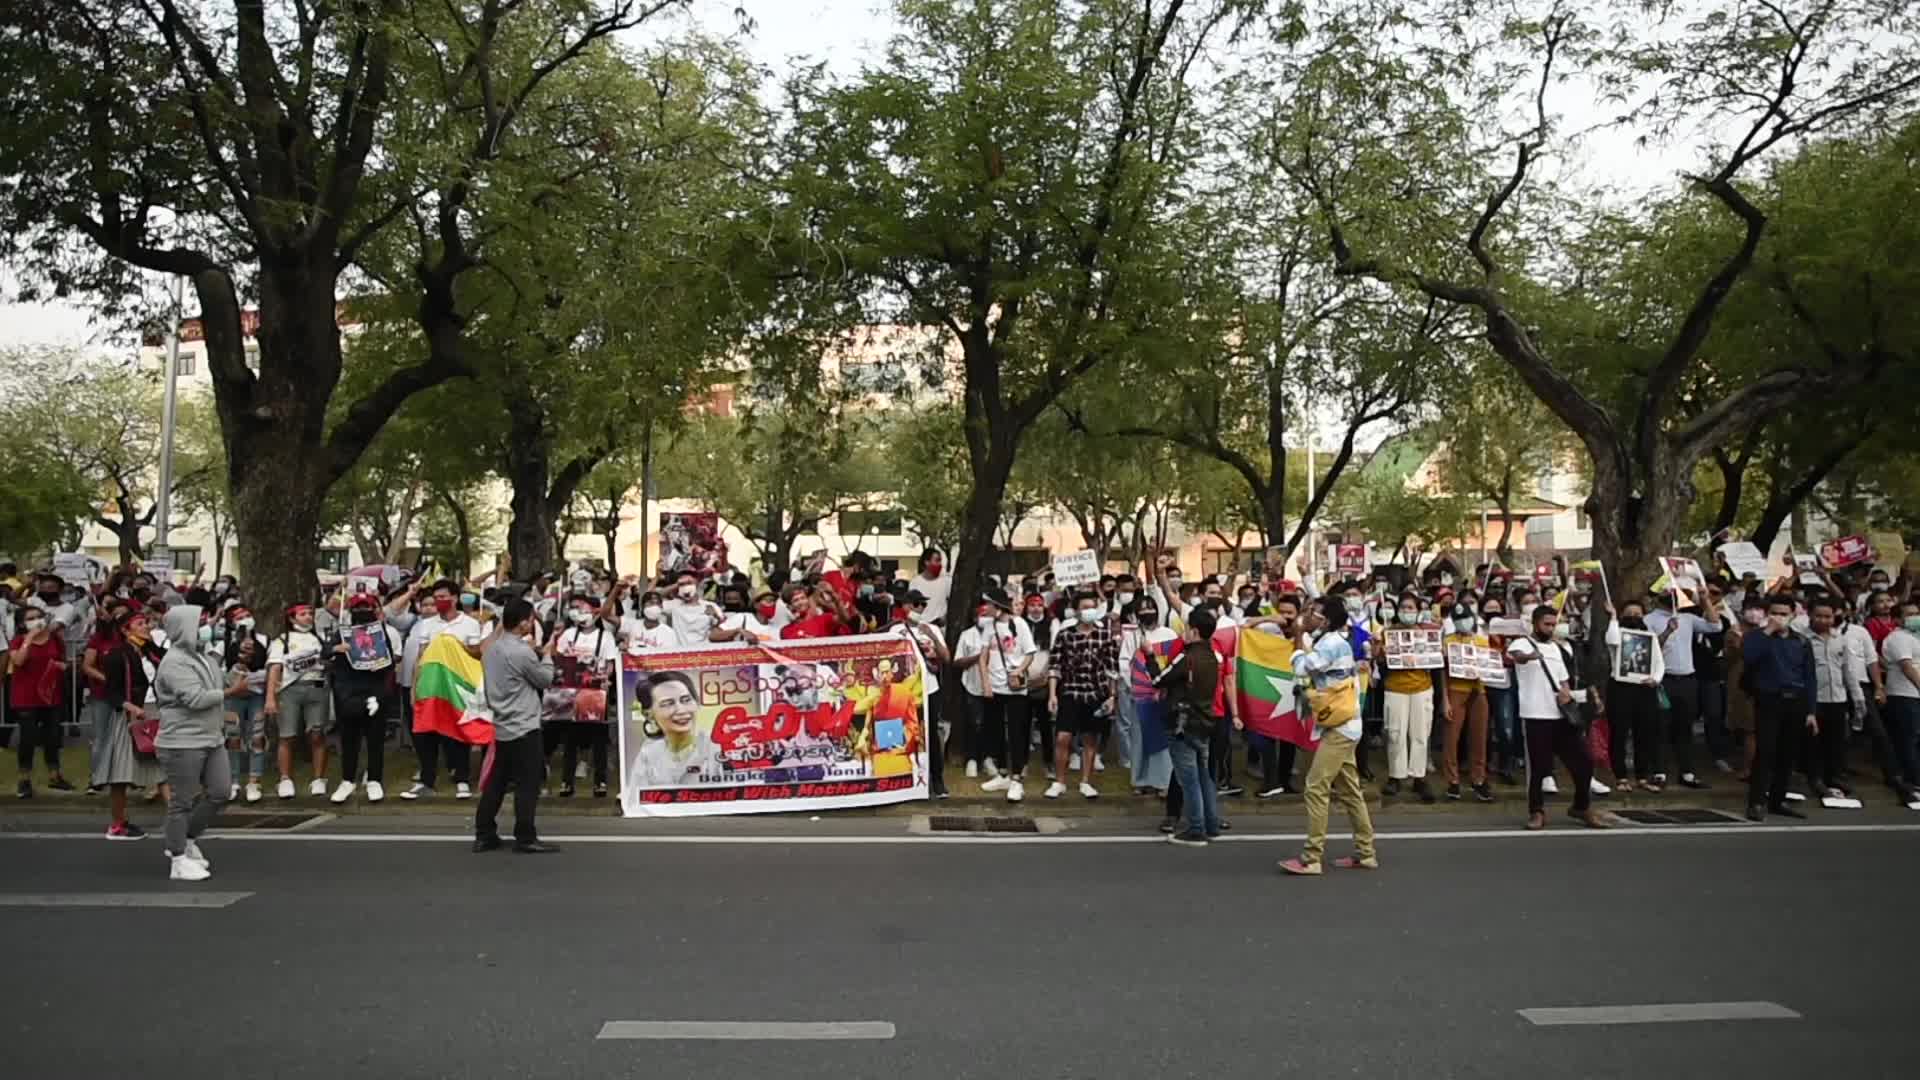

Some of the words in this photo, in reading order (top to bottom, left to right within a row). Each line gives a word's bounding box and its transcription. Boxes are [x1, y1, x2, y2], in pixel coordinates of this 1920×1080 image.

[641, 788, 673, 804] We
[743, 781, 793, 800] With
[797, 779, 871, 798] Mother
